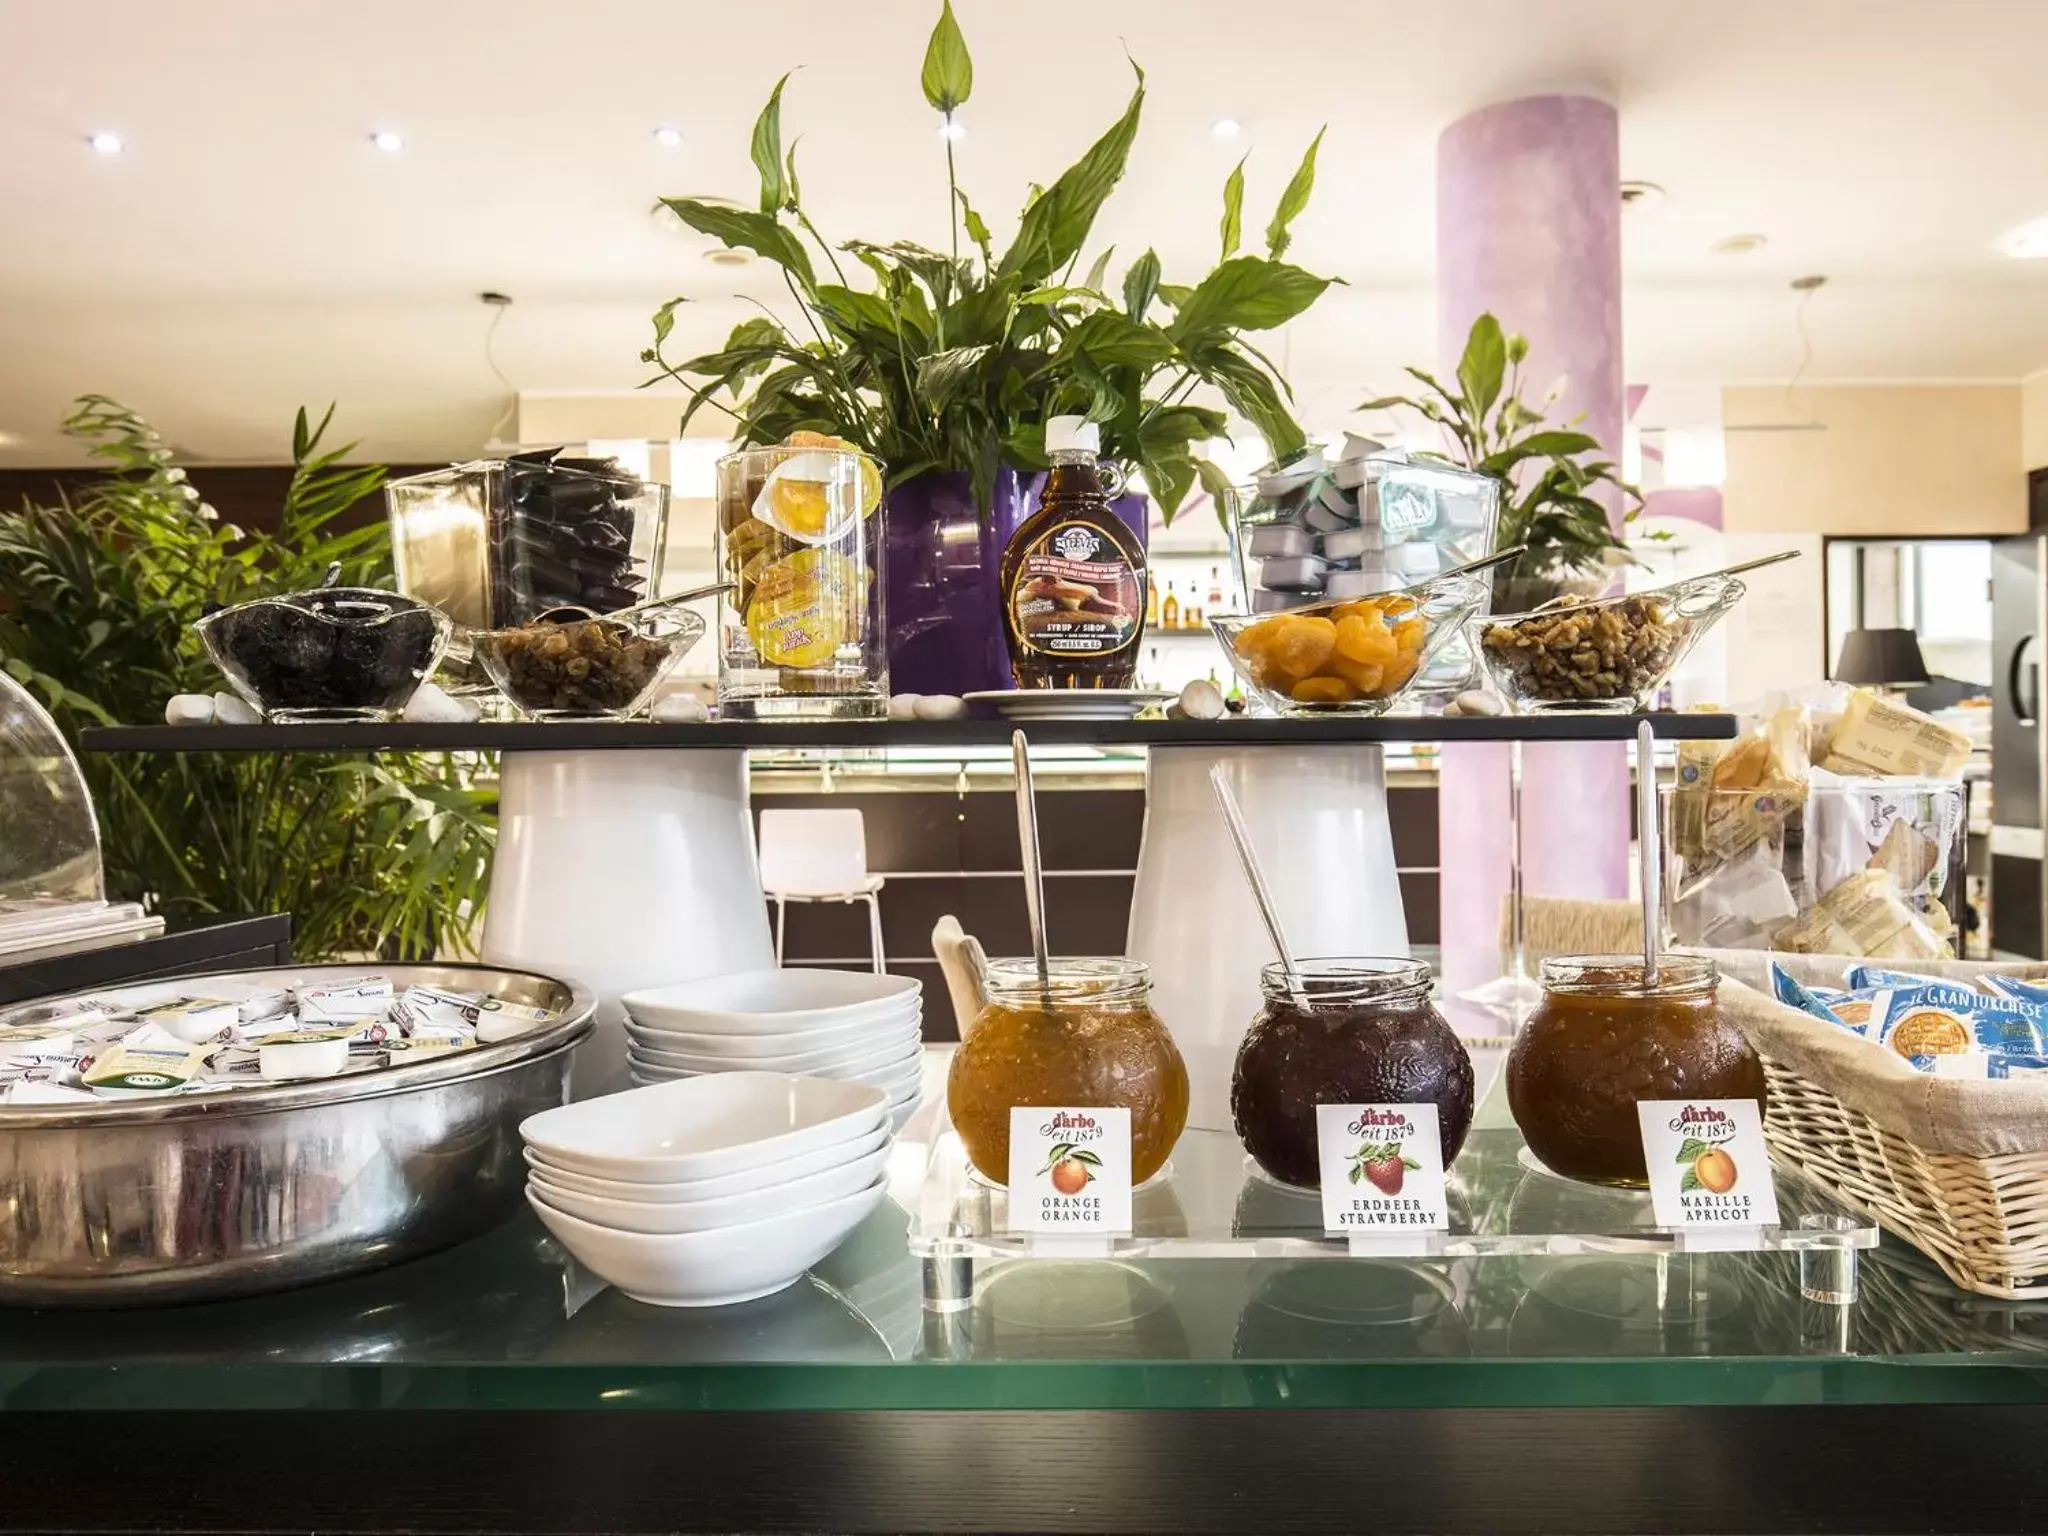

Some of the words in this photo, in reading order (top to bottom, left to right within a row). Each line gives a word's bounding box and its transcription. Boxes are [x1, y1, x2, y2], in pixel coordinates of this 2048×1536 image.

[1046, 623, 1073, 632] SYRUP
[1083, 623, 1107, 632] SIROP
[1039, 1122, 1071, 1142] Seit
[1074, 1125, 1104, 1143] 1879
[1346, 1121, 1381, 1141] Seit
[1384, 1121, 1415, 1141] 1879
[1668, 1117, 1702, 1137] Seit
[1706, 1118, 1737, 1138] 1879
[1041, 1197, 1101, 1209] ORANGE
[1353, 1199, 1422, 1211] ERDBEER
[1680, 1195, 1752, 1208] MARILLE
[1041, 1210, 1101, 1222] ORANGE
[1339, 1212, 1437, 1225] STRAWBERRY
[1686, 1208, 1751, 1221] APRICOT
